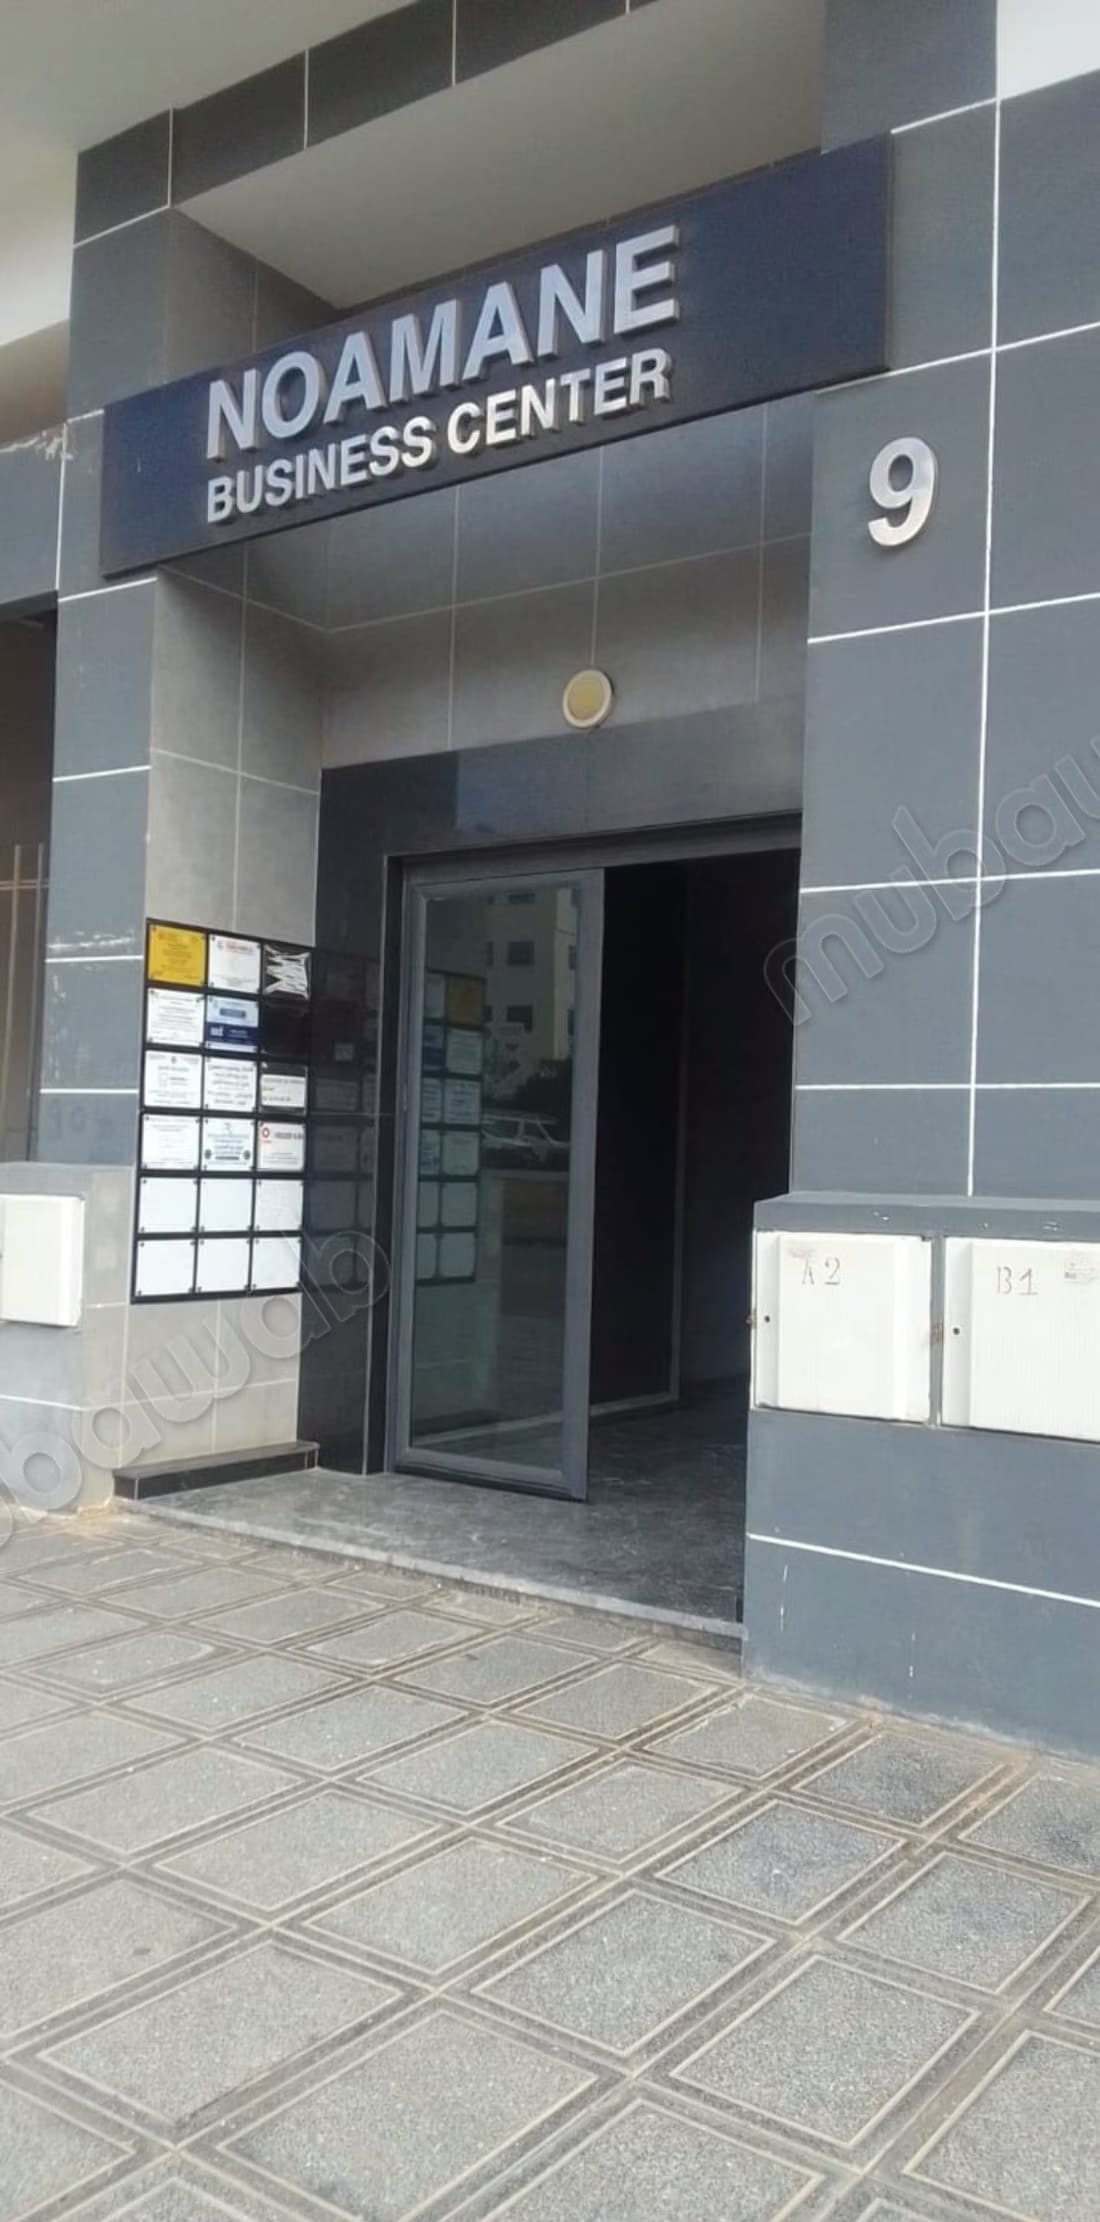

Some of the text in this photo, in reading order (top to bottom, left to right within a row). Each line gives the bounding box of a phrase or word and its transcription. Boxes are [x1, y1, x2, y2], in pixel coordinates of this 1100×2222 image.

[206, 225, 680, 461] NOAMANE
[207, 347, 673, 524] BUSINESS CENTER
[868, 436, 936, 547] 9
